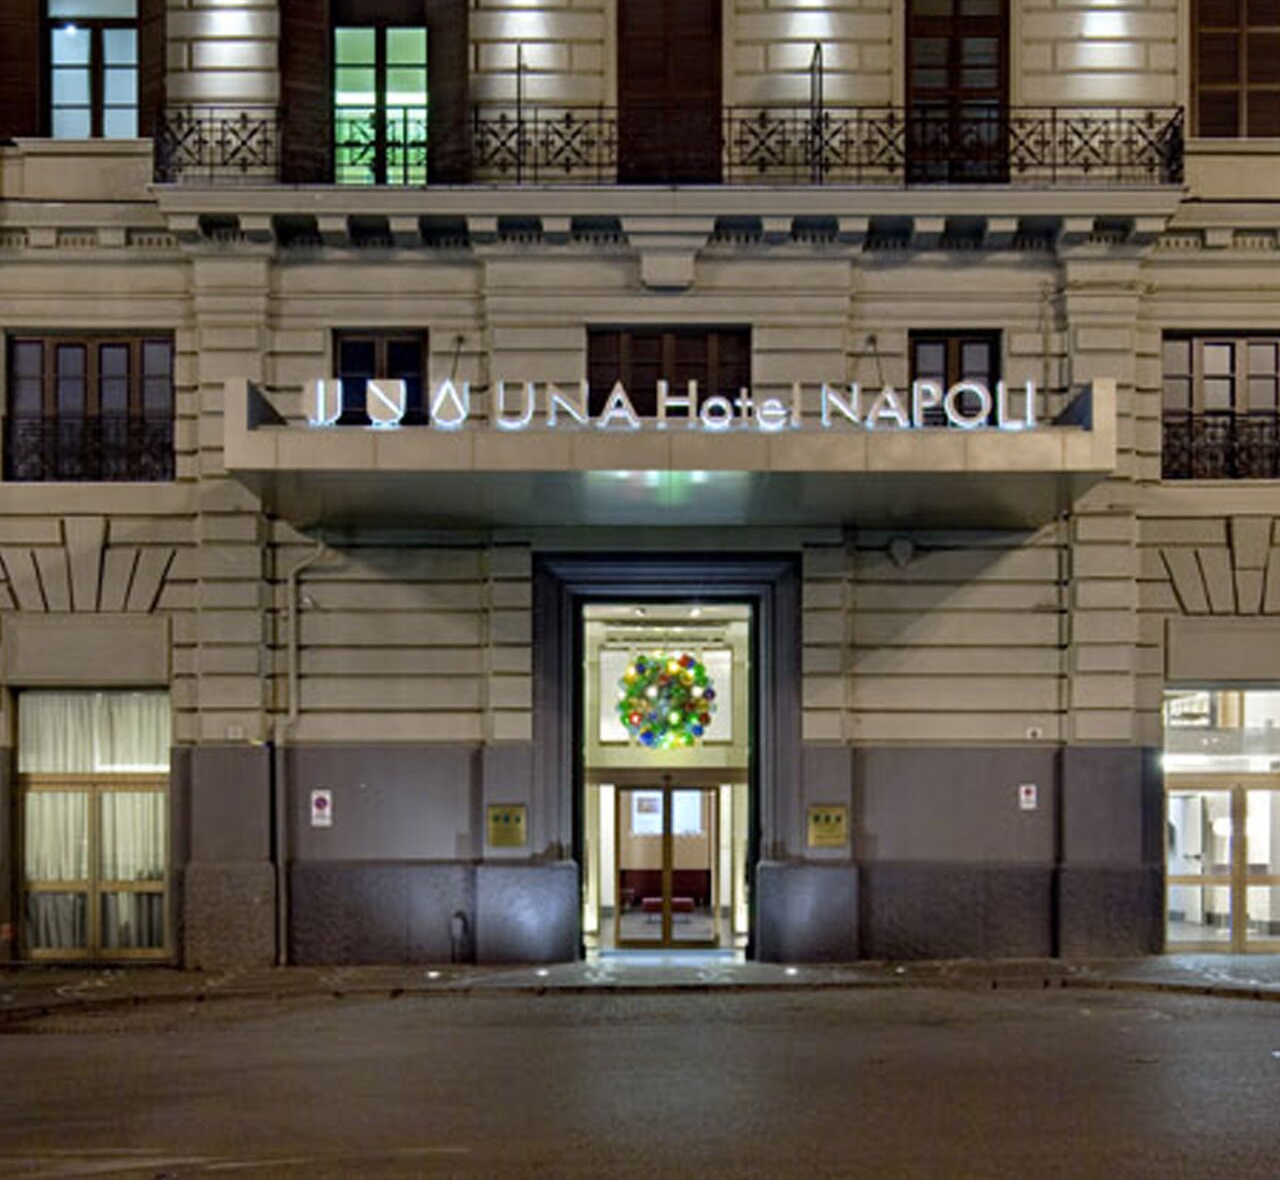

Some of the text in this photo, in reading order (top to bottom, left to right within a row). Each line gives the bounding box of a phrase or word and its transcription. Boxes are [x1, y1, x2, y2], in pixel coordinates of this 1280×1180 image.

[495, 378, 1037, 431] UNA Hotel NAPOLI
